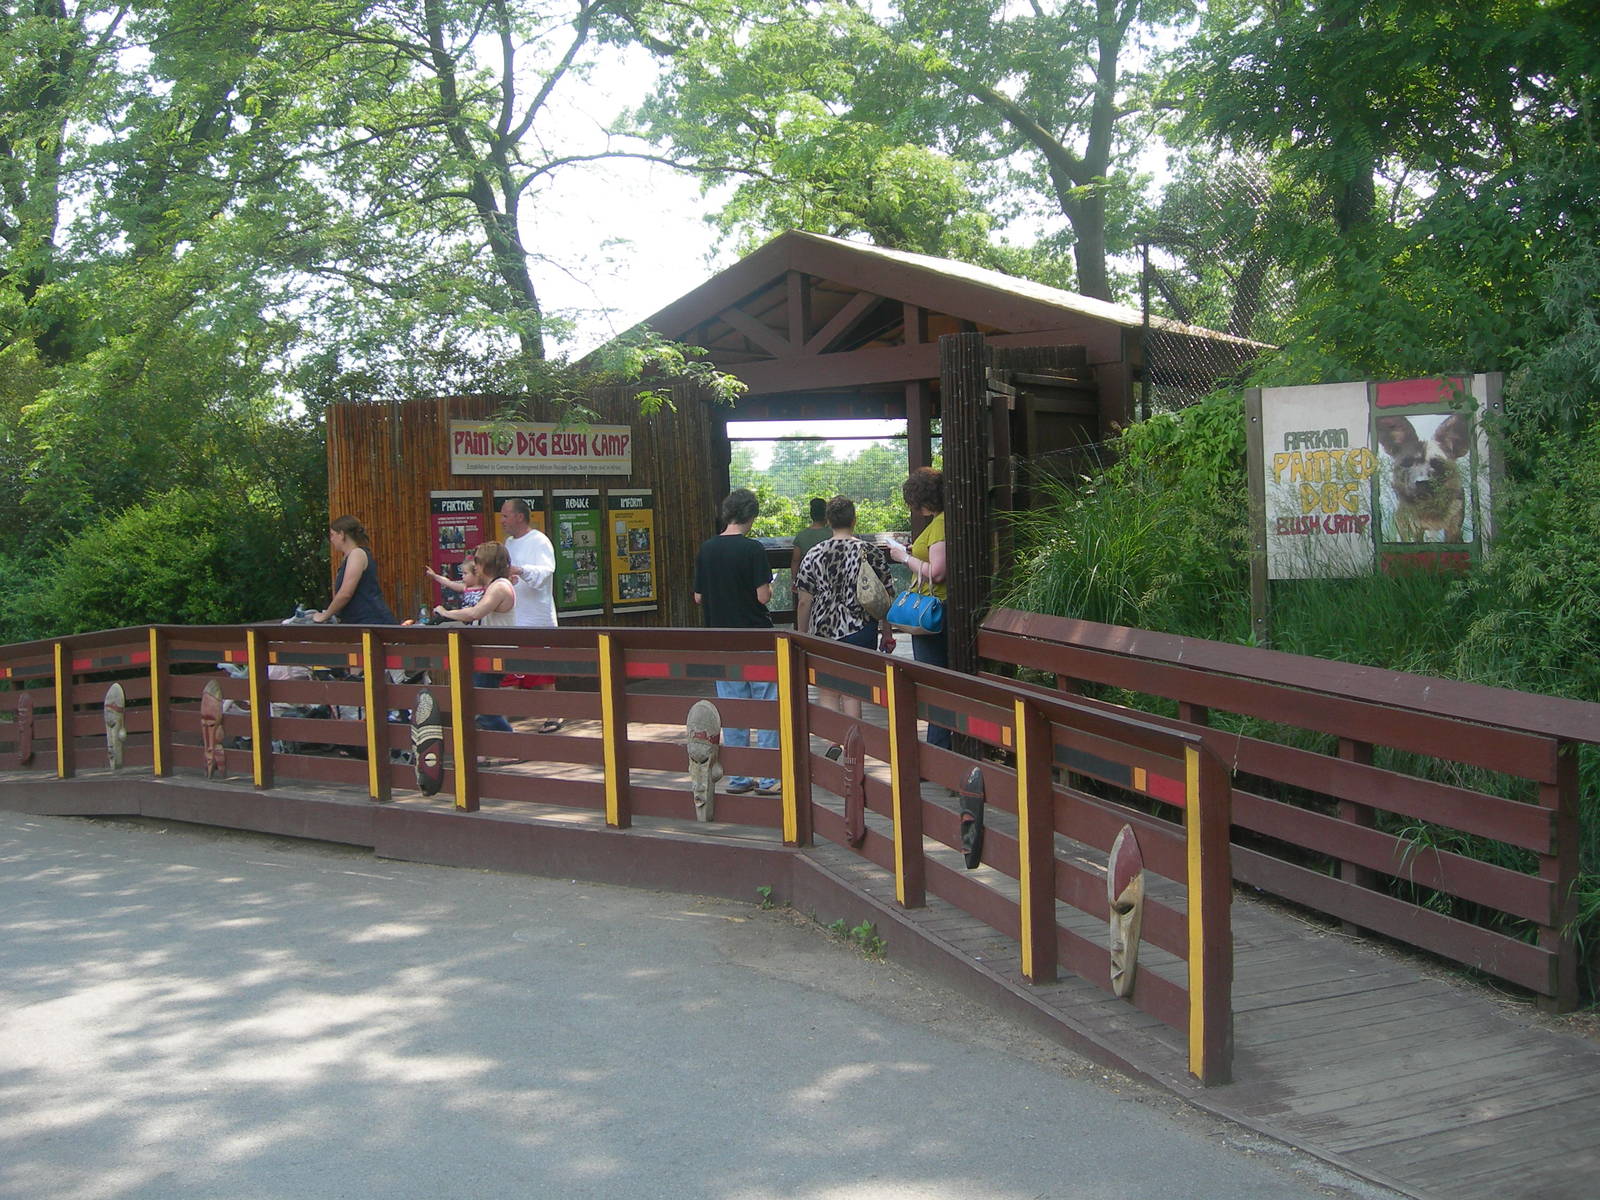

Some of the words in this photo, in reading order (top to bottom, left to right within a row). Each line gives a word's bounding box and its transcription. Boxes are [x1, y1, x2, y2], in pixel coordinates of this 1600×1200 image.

[551, 433, 588, 457] BUSH
[592, 434, 630, 457] CAMP
[1274, 448, 1377, 483] PAINTED
[441, 500, 475, 512] PARTNER
[1300, 479, 1359, 513] DOG
[1276, 515, 1321, 535] BUSH
[1322, 514, 1370, 535] CAMP
